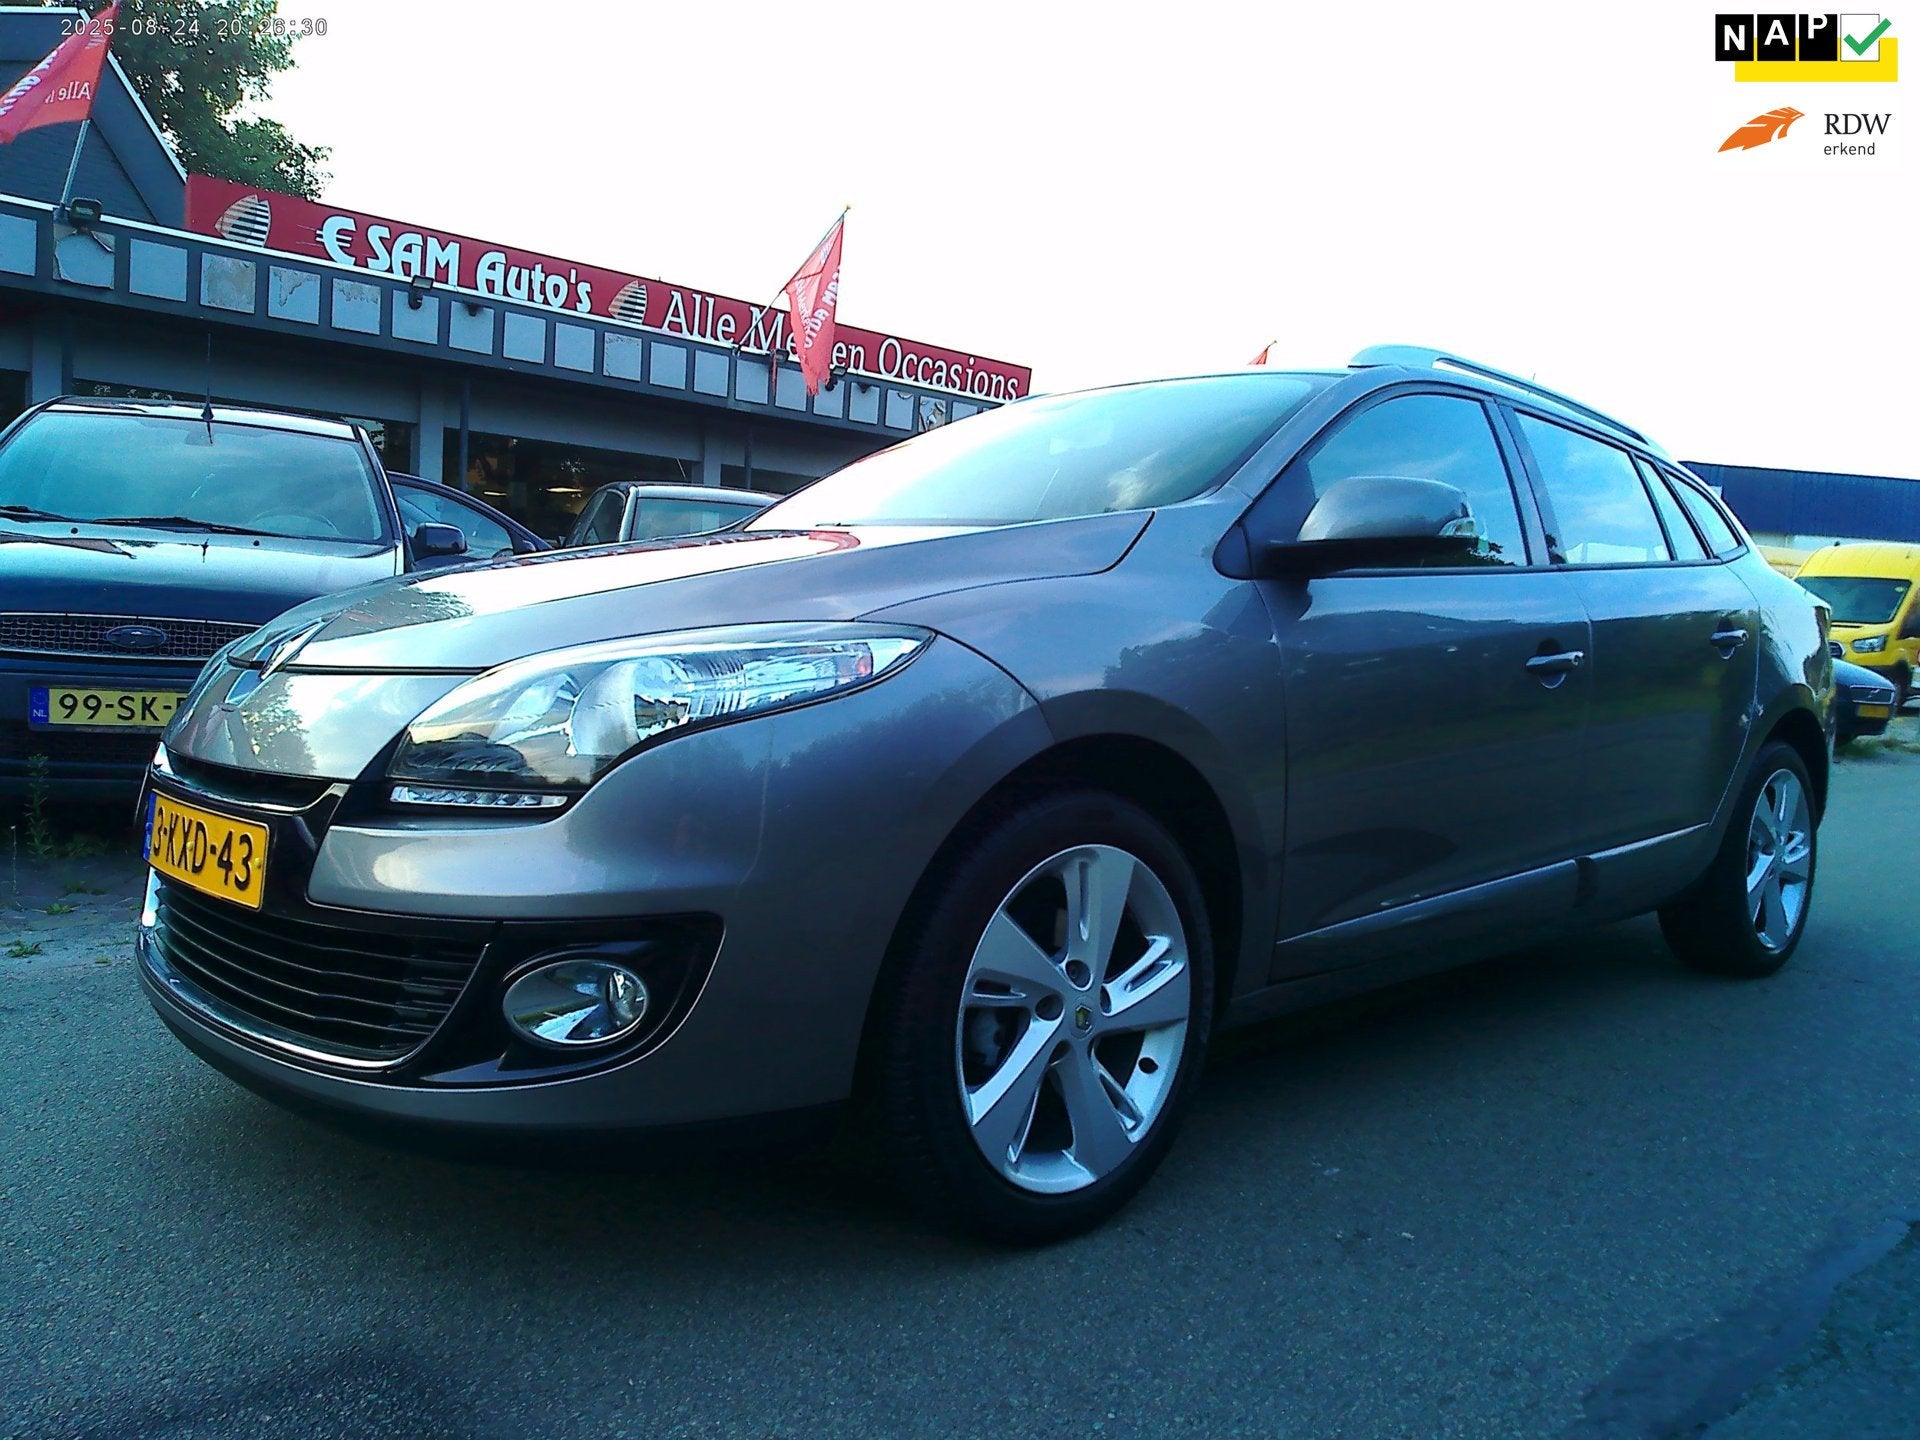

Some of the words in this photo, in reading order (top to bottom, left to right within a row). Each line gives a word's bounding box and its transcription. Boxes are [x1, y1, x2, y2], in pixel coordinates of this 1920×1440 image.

[366, 224, 460, 288] SAM
[476, 251, 592, 314] Auto's
[661, 290, 736, 344] Alle
[749, 306, 866, 376] Meen
[878, 338, 1020, 403] Occasions
[32, 709, 48, 718] NL
[153, 806, 254, 891] 3-KXD-43
